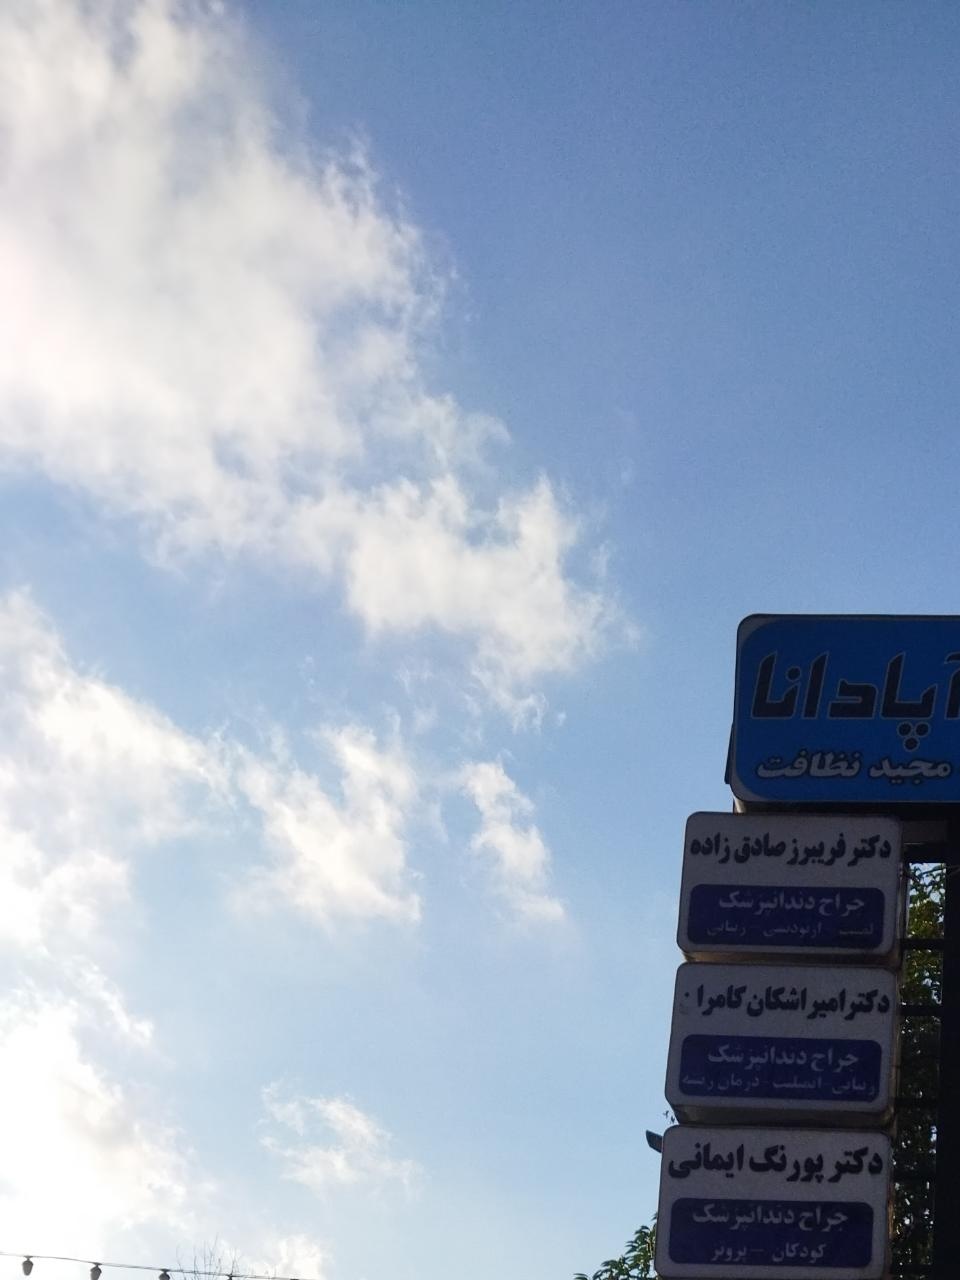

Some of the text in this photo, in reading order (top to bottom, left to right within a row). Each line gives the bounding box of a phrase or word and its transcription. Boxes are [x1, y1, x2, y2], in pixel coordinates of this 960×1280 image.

[757, 749, 862, 779] نظافت
[868, 754, 952, 785] مجید
[690, 832, 891, 867] دکتر فریبرز صادق زاده
[818, 891, 865, 917] جراح
[746, 987, 808, 1018] اشکان
[806, 988, 847, 1020] امیر
[844, 989, 890, 1021] دکتر
[808, 1048, 860, 1073] جراح
[668, 1142, 884, 1183] دکتر پورنگ ایمانی
[798, 1205, 849, 1232] جراح
